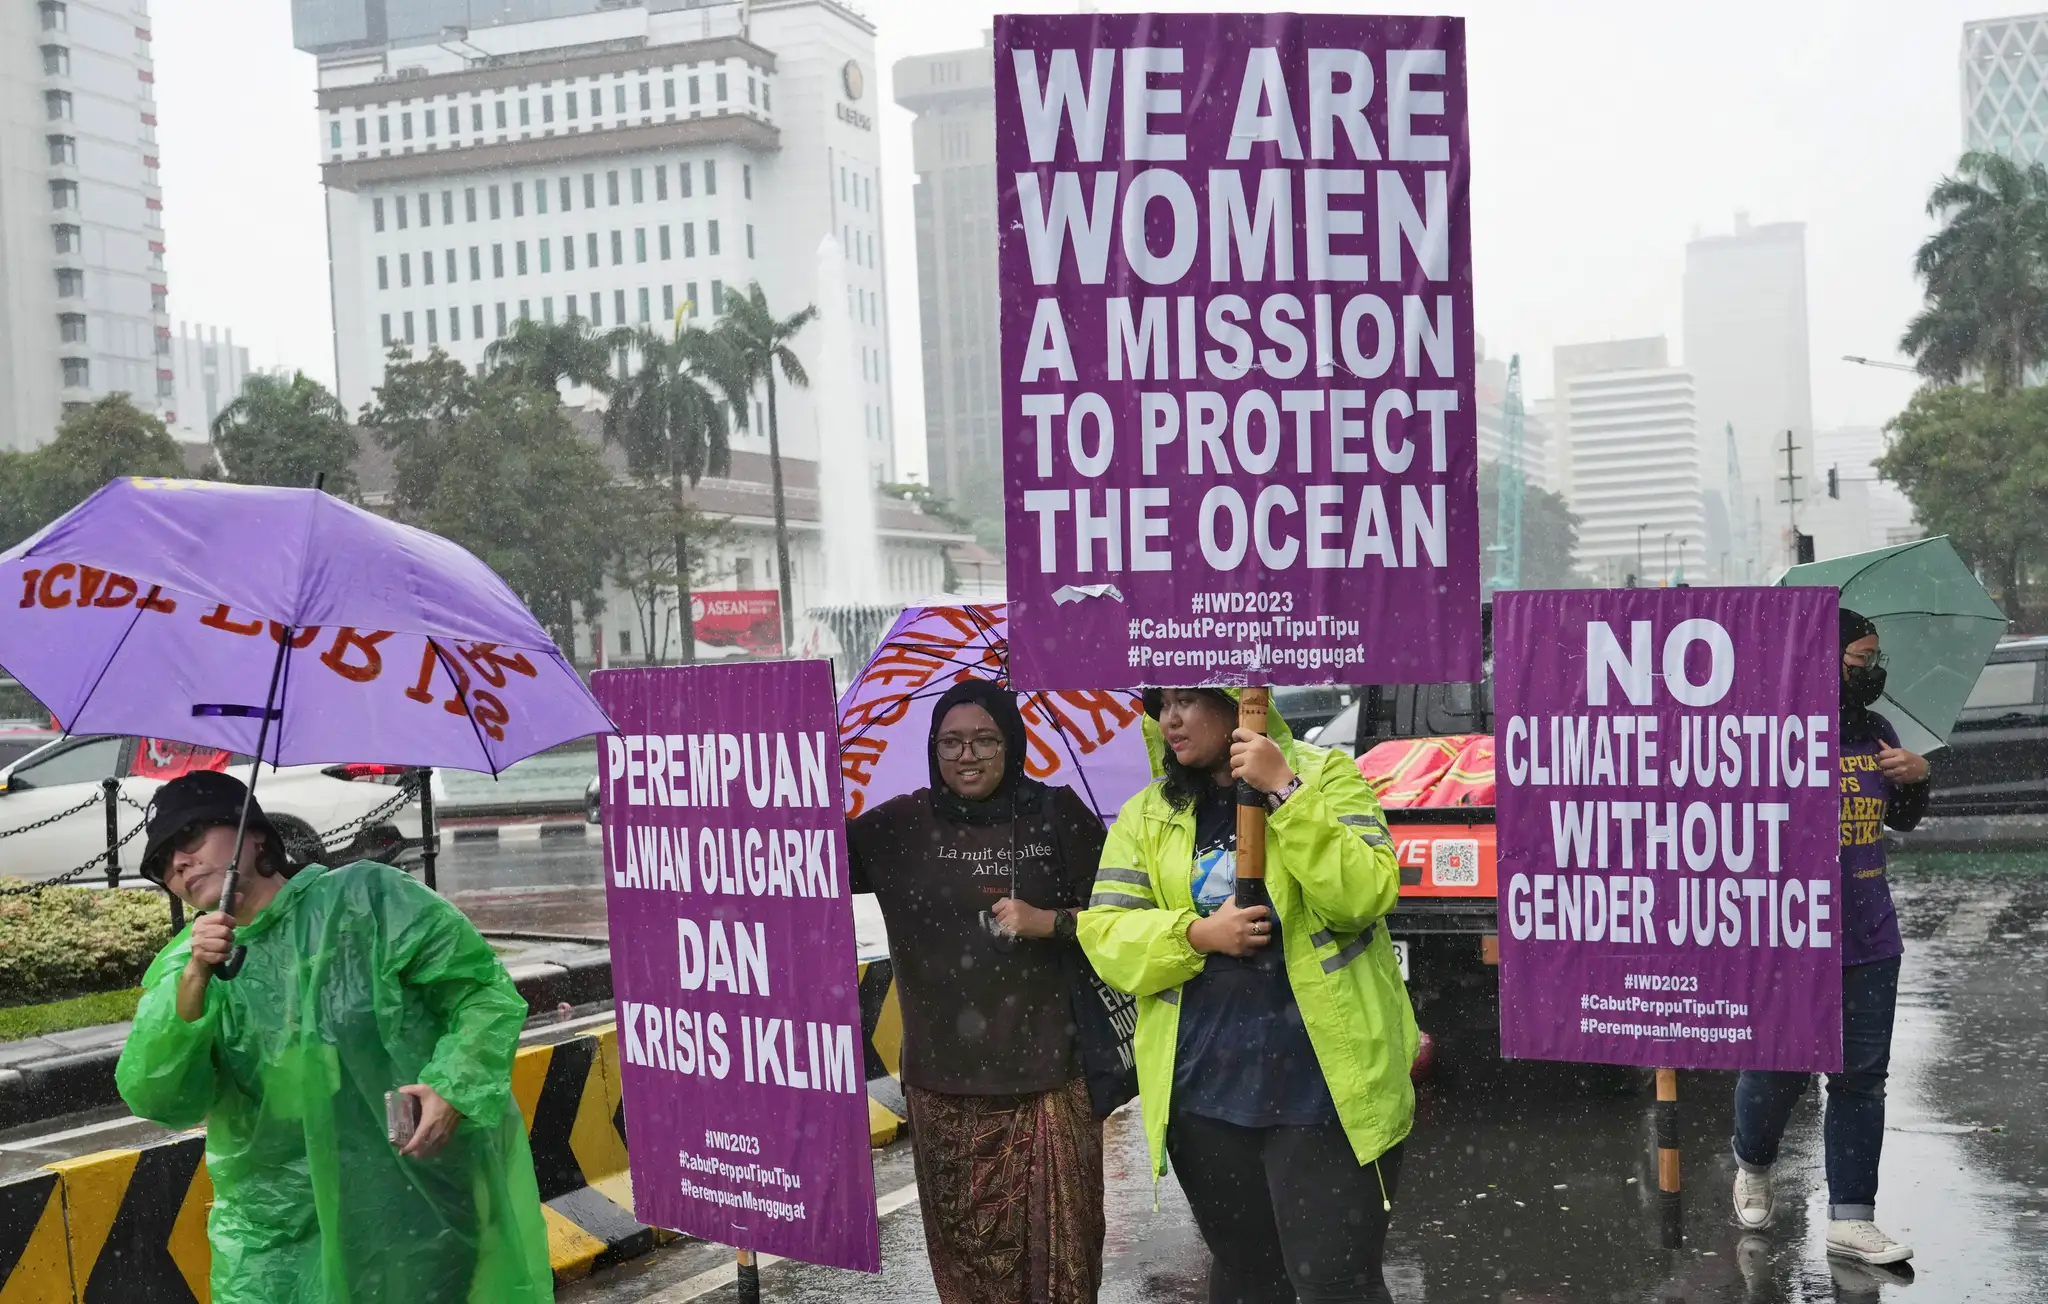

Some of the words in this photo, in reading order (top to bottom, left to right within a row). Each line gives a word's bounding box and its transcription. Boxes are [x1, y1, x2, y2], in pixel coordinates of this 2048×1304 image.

[1012, 47, 1187, 162] WE
[1226, 47, 1450, 162] ARE
[1015, 168, 1449, 286] WOMEN
[1020, 297, 1078, 382] A
[1107, 293, 1455, 382] MISSION
[1020, 392, 1114, 478] TO
[1141, 388, 1458, 476] PROTECT
[1024, 487, 1171, 573] THE
[1198, 484, 1448, 571] OCEAN
[707, 600, 748, 616] ASEAN
[1128, 616, 1360, 642] #CabutPerppuTipuTipu
[1191, 591, 1294, 614] #IWD2023
[1127, 643, 1365, 670] #PerempuanMenggugat
[1587, 619, 1735, 707] NO
[607, 731, 831, 809] PEREMPUAN
[1506, 714, 1659, 787] CLIMATE
[1669, 714, 1830, 788] JUSTICE
[609, 824, 693, 893] LAWAN
[699, 827, 840, 899] OLIGARKI
[937, 846, 957, 859] La
[962, 847, 993, 861] nuit
[1550, 800, 1790, 873] WITHOUT
[1507, 872, 1658, 944] GENDER
[1668, 878, 1832, 949] JUSTICE
[677, 917, 770, 997] DAN
[1624, 973, 1698, 992] #IWD2023
[1580, 994, 1749, 1018] #CabutPerppuTipuTipu
[1580, 1018, 1753, 1043] #PerempuanMenggugat
[622, 1001, 731, 1081] KRISIS
[741, 1015, 857, 1094] IKLIM
[679, 1150, 801, 1192] #CabutPerppuTipuTipu
[705, 1129, 760, 1155] #IWD2023
[680, 1178, 806, 1222] #PerempuanMenggugat
